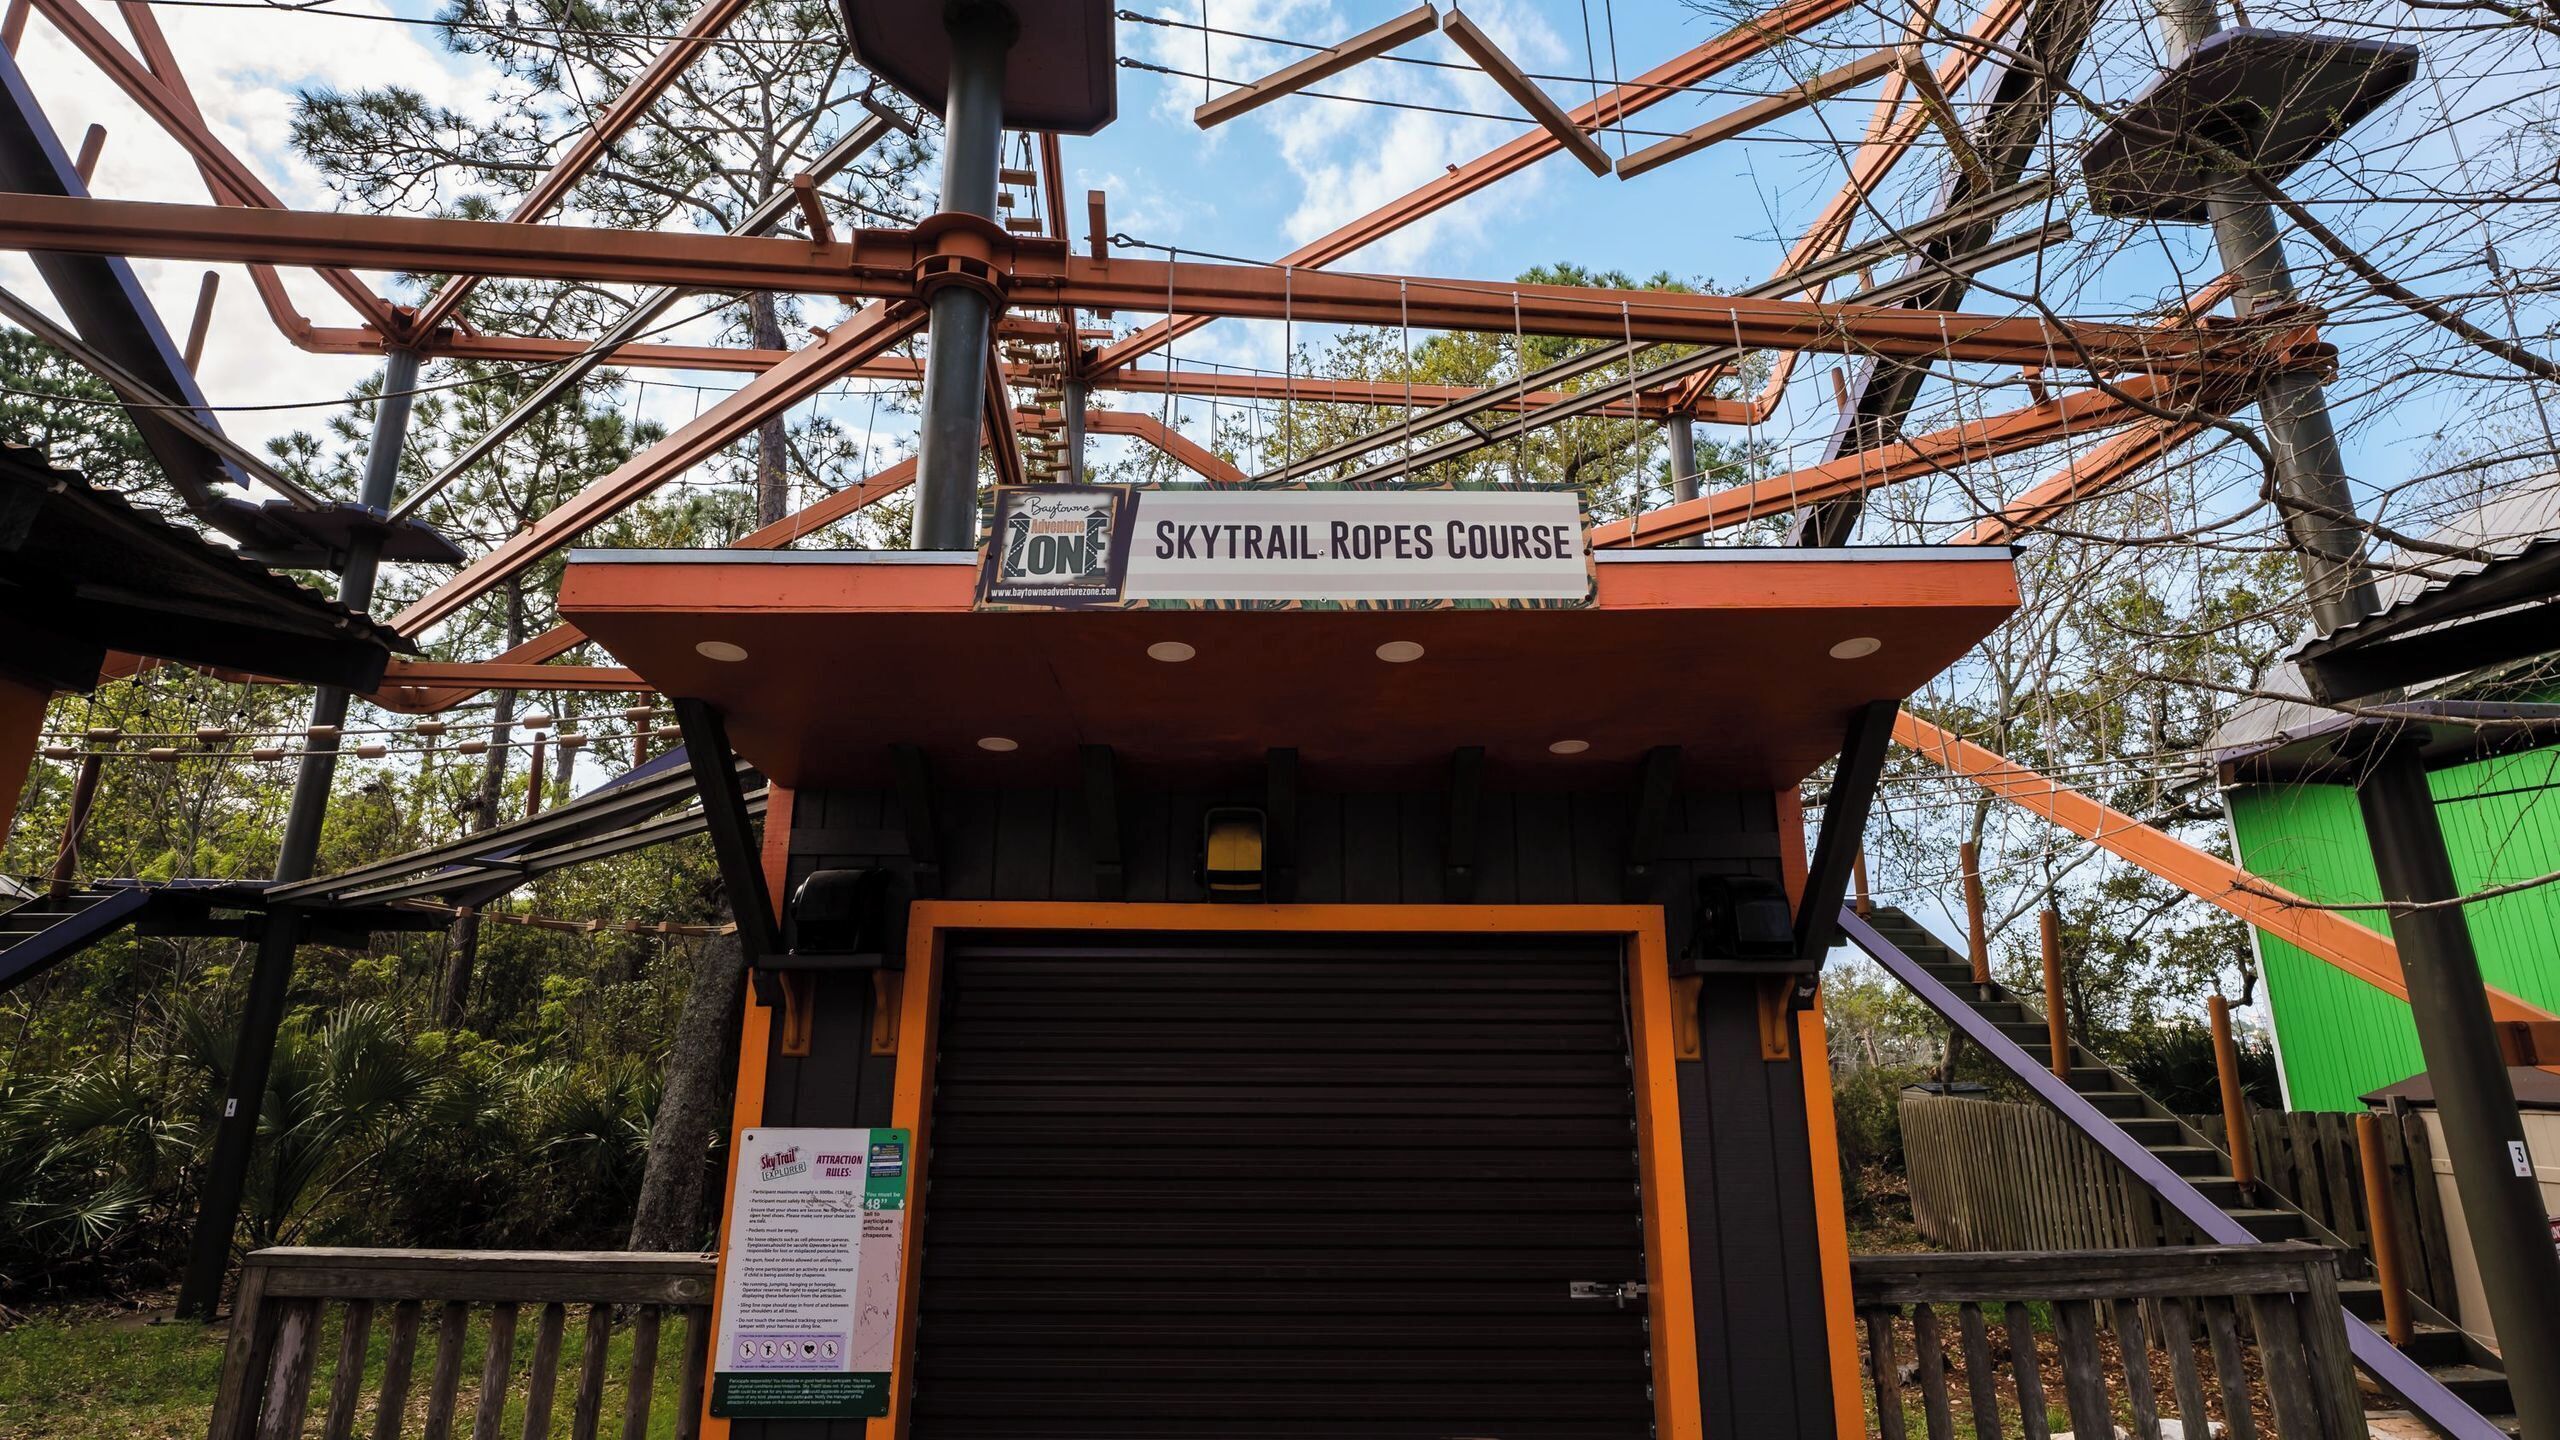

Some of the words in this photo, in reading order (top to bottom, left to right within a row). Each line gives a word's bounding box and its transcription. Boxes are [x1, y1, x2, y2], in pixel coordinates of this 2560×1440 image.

[1024, 496, 1091, 519] Baytowne
[1030, 519, 1086, 534] Adventure
[1002, 517, 1108, 578] ZONE
[1155, 519, 1318, 561] SKYTRAIL
[1331, 519, 1434, 561] ROPES
[1447, 519, 1573, 560] COURSE
[991, 587, 1118, 599] www.baytowneadventurezone.com
[761, 1153, 776, 1170] Sky
[816, 1155, 863, 1165] ATTRACTION
[2514, 1146, 2525, 1163] 3
[764, 1163, 805, 1180] EXPLORER
[825, 1168, 852, 1177] RULES:
